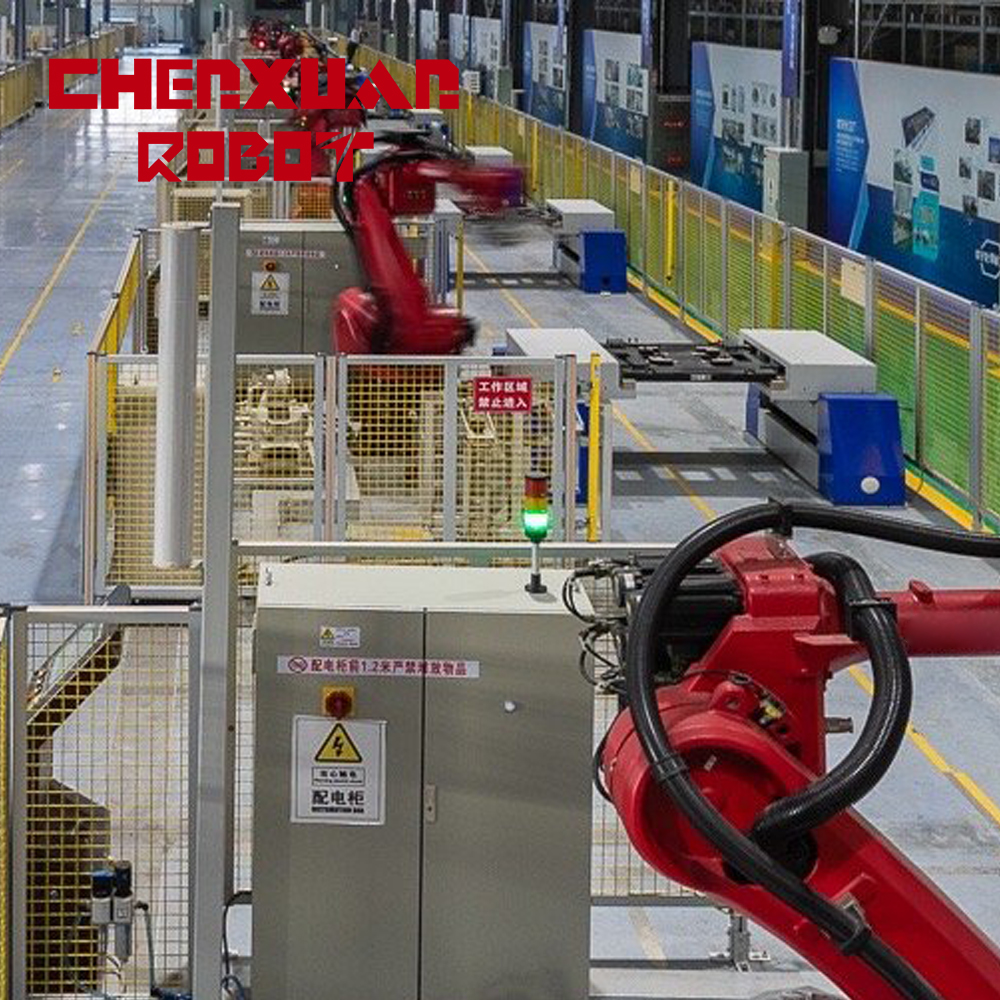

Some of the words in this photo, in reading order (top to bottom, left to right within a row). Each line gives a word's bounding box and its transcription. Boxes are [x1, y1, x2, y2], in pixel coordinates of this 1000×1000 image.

[478, 381, 528, 393] 工作区域
[478, 396, 528, 408] 禁止进入
[312, 790, 365, 805] 配电柜
